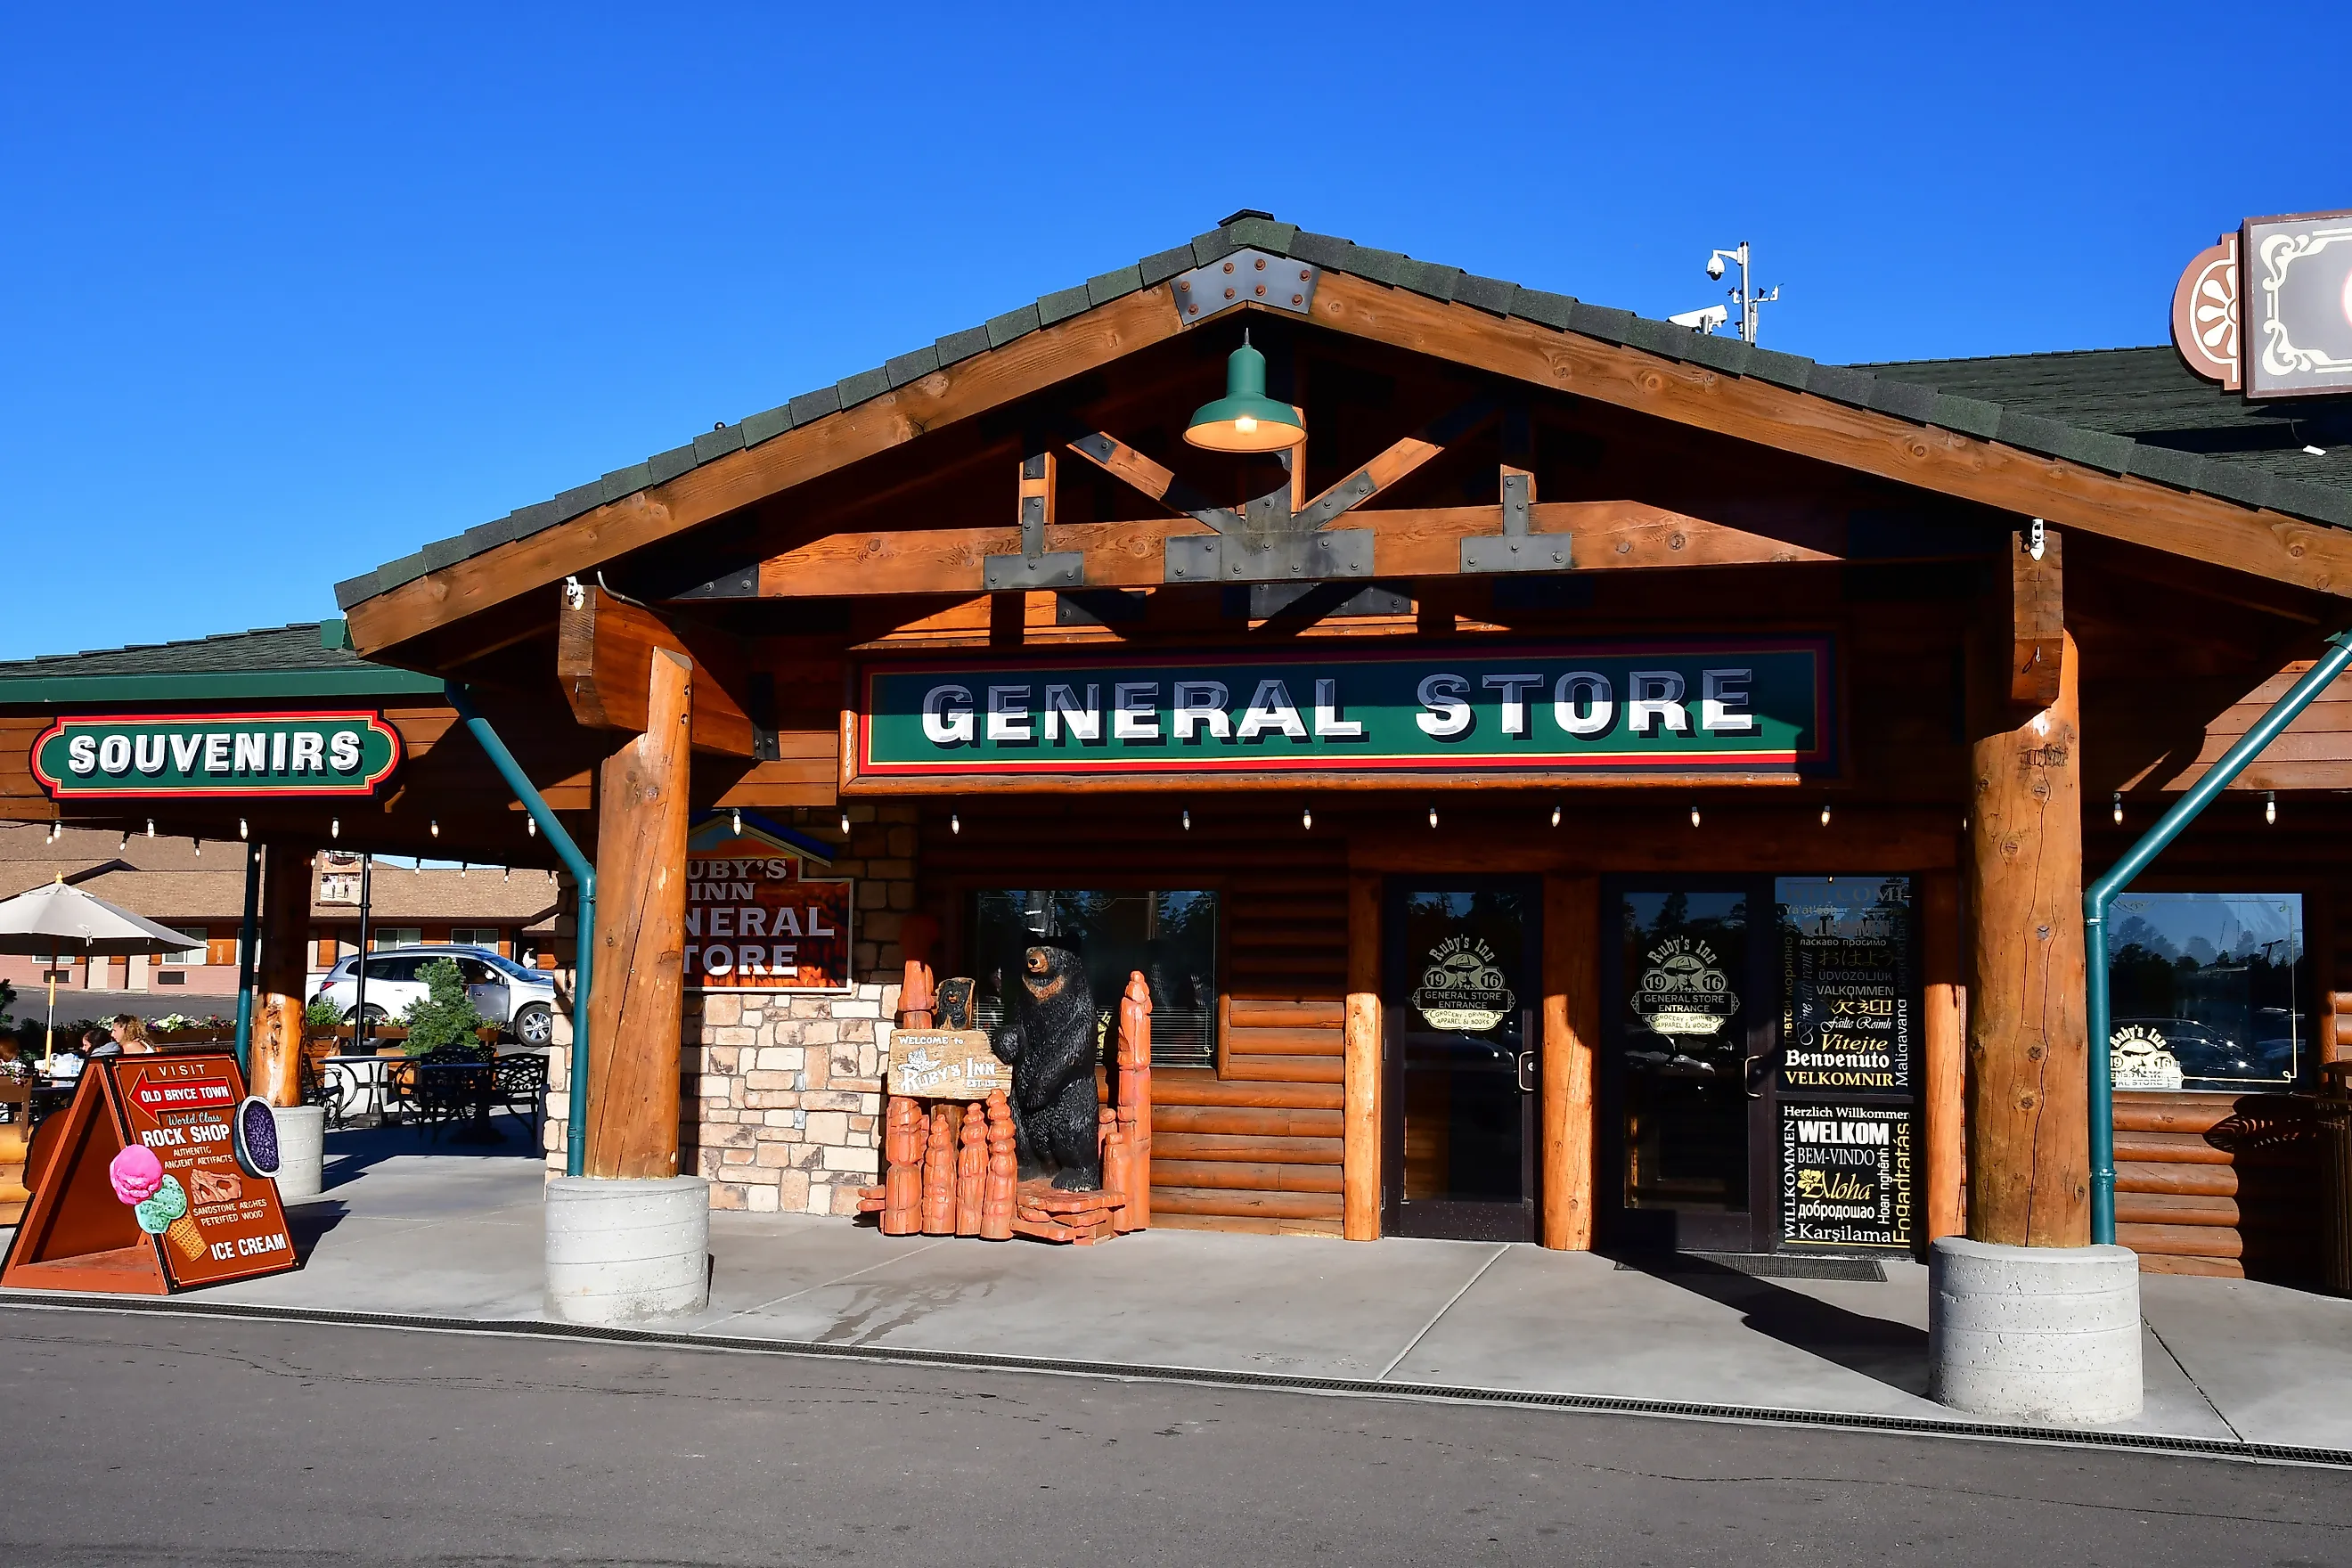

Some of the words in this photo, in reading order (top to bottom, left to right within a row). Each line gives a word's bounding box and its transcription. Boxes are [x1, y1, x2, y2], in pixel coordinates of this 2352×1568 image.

[922, 679, 1361, 742] GENERAL
[1416, 669, 1752, 736] STORE
[68, 731, 361, 773] SOUVENIRS
[687, 859, 787, 879] UBY'S
[690, 882, 755, 901] INN
[685, 906, 835, 936] NERAL
[1429, 934, 1470, 962] Ruby's
[1474, 938, 1495, 962] Inn
[1647, 935, 1690, 964] Ruby's
[1695, 940, 1717, 964] Inn
[1800, 938, 1839, 946] ласкаво
[1842, 938, 1887, 948] просимо
[683, 944, 798, 976] TORE
[1427, 973, 1444, 987] 19
[1482, 975, 1499, 988] 16
[1646, 976, 1664, 990] 19
[1704, 976, 1721, 990] 16
[1425, 991, 1469, 1000] GENERAL
[1471, 992, 1501, 1000] STORE
[1438, 1001, 1488, 1009] ENTRANCE
[1644, 994, 1690, 1003] GENERAL
[1693, 995, 1725, 1004] STORE
[1659, 1005, 1710, 1013] ENTRANCE
[898, 1036, 949, 1045] WELCOME
[953, 1037, 964, 1045] to
[1821, 1034, 1888, 1054] Vítejte
[2147, 1027, 2168, 1049] Inn
[1784, 1049, 1890, 1068] Benvenuto
[2154, 1058, 2171, 1068] 16
[159, 1064, 205, 1076] VISIT
[1784, 1071, 1894, 1087] VELKOMNIR
[141, 1090, 162, 1103] OLD
[164, 1088, 198, 1101] BRYCE
[199, 1085, 229, 1098] TOWN
[167, 1112, 198, 1126] World
[199, 1112, 222, 1123] Class
[1784, 1106, 1833, 1118] Herzlich
[141, 1127, 186, 1147] ROCK
[190, 1123, 230, 1143] SHOP
[1797, 1120, 1890, 1146] WELKOM
[173, 1146, 212, 1157] AUTHENTIC
[1797, 1147, 1875, 1166] BEM-VINDO
[164, 1158, 194, 1169] ANCIENT
[197, 1155, 233, 1165] ARTIFACTS
[1784, 1120, 1796, 1238] WILLKOMMEN
[1801, 1169, 1874, 1201] Aloha
[192, 1203, 237, 1217] SANDSTONE
[240, 1198, 267, 1210] ARCHES
[1798, 1200, 1875, 1221] добродошао
[1877, 1194, 1891, 1225] Hoan
[200, 1213, 239, 1227] PETRIFIED
[241, 1210, 264, 1221] WOOD
[210, 1241, 235, 1261] ICE
[237, 1233, 287, 1256] CREAM
